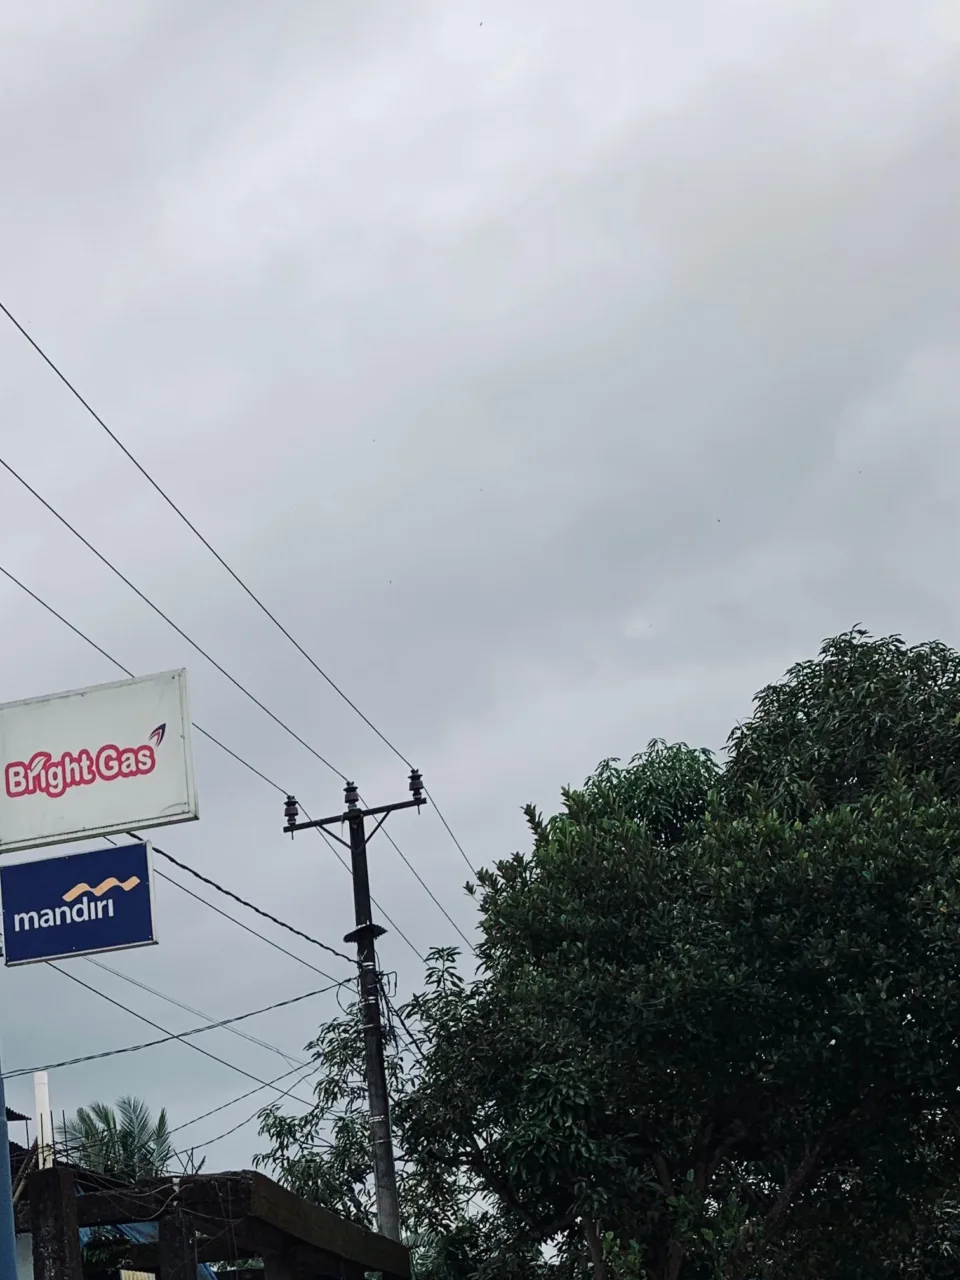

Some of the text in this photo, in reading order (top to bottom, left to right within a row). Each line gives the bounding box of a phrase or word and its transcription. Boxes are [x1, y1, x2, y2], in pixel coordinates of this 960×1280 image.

[5, 743, 156, 798] Bright Gas
[13, 897, 115, 932] mandiri
